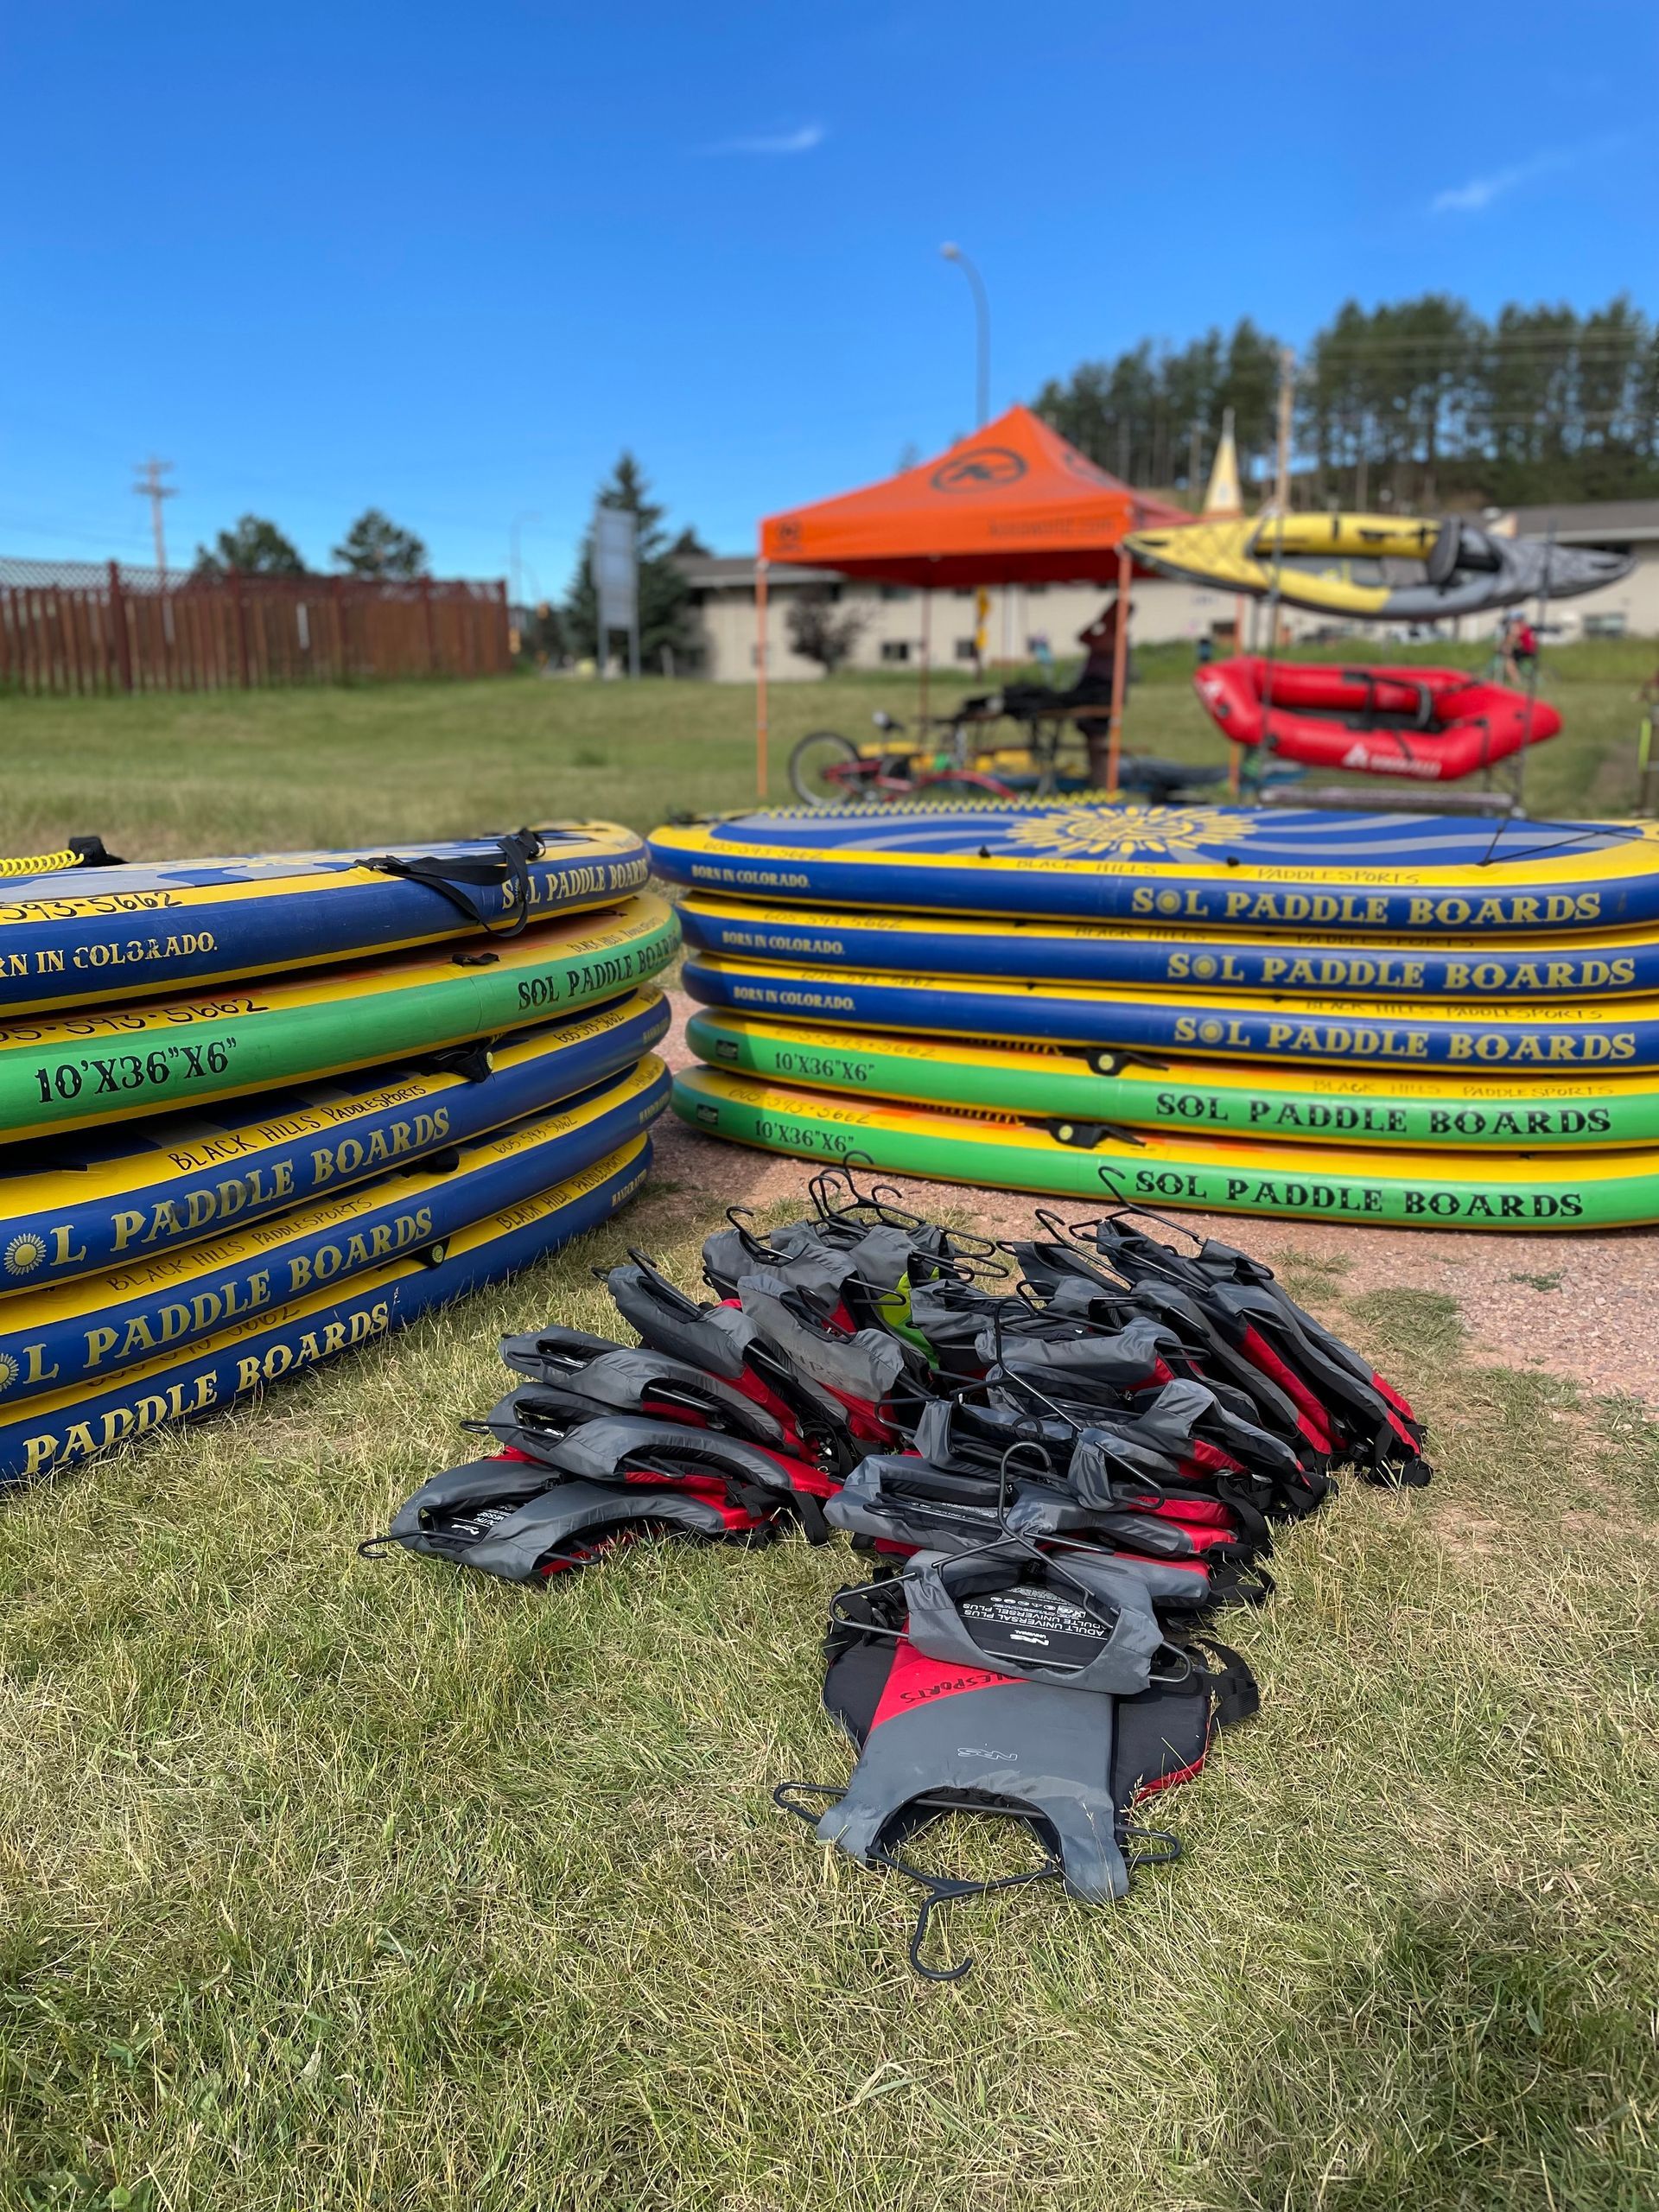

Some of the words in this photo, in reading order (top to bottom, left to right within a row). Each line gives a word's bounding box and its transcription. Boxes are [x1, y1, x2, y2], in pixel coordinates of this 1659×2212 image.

[545, 866, 606, 901] PADDLE
[608, 858, 648, 891] BOARDS
[691, 865, 721, 880] BORN
[723, 868, 735, 882] IN
[736, 870, 810, 888] COLORADO.
[1096, 862, 1157, 875] HILLS
[1224, 891, 1389, 924] PADDLE
[1407, 893, 1601, 925] BOARDS
[721, 931, 753, 946] BORN
[754, 934, 767, 948] IN
[769, 935, 845, 955] COLORADO.
[35, 950, 66, 974] IN
[1260, 957, 1425, 988] PADDLE
[1442, 957, 1636, 989] BOARDS
[518, 976, 560, 1010] SOL
[567, 953, 632, 998] PADDLE
[733, 986, 764, 1001] BORN
[766, 989, 779, 1003] IN
[779, 991, 855, 1011] COLORADO.
[1446, 1007, 1603, 1020] PADDLESPORTS
[1267, 1023, 1429, 1057] PADDLE
[1446, 1032, 1637, 1060] BOARDS
[1462, 1084, 1614, 1097] PADDLESPORTS
[1156, 1092, 1229, 1122] SOL
[1249, 1099, 1408, 1133] PADDLE
[1428, 1108, 1611, 1135] BOARDS
[168, 1135, 257, 1171] BLACK
[267, 1115, 323, 1142] HILLS
[321, 1084, 427, 1122] PADDLESPORTS
[110, 1160, 295, 1253] PADDLE
[311, 1106, 451, 1185] BOARDS
[1135, 1170, 1207, 1199] SOL
[1226, 1179, 1383, 1212] PADDLE
[1403, 1191, 1584, 1217] BOARDS
[496, 1204, 543, 1230] BLACK
[540, 1189, 573, 1211] HILLS
[106, 1259, 194, 1292] BLACK
[193, 1240, 245, 1268] HILLS
[252, 1196, 372, 1246] PADDLESPORTS
[83, 1268, 271, 1369] PADDLE
[289, 1205, 433, 1293] BOARDS
[22, 1370, 219, 1477] PADDLE
[237, 1301, 388, 1393] BOARDS
[963, 1603, 994, 1613] PLUS
[963, 1610, 995, 1619] PLUS
[994, 1608, 1060, 1624] UNIVERSEL
[998, 1615, 1063, 1630] UNIVERSAL
[1065, 1624, 1105, 1637] ADULT
[1010, 1633, 1050, 1646] NRS
[957, 1747, 1018, 1762] NRS
